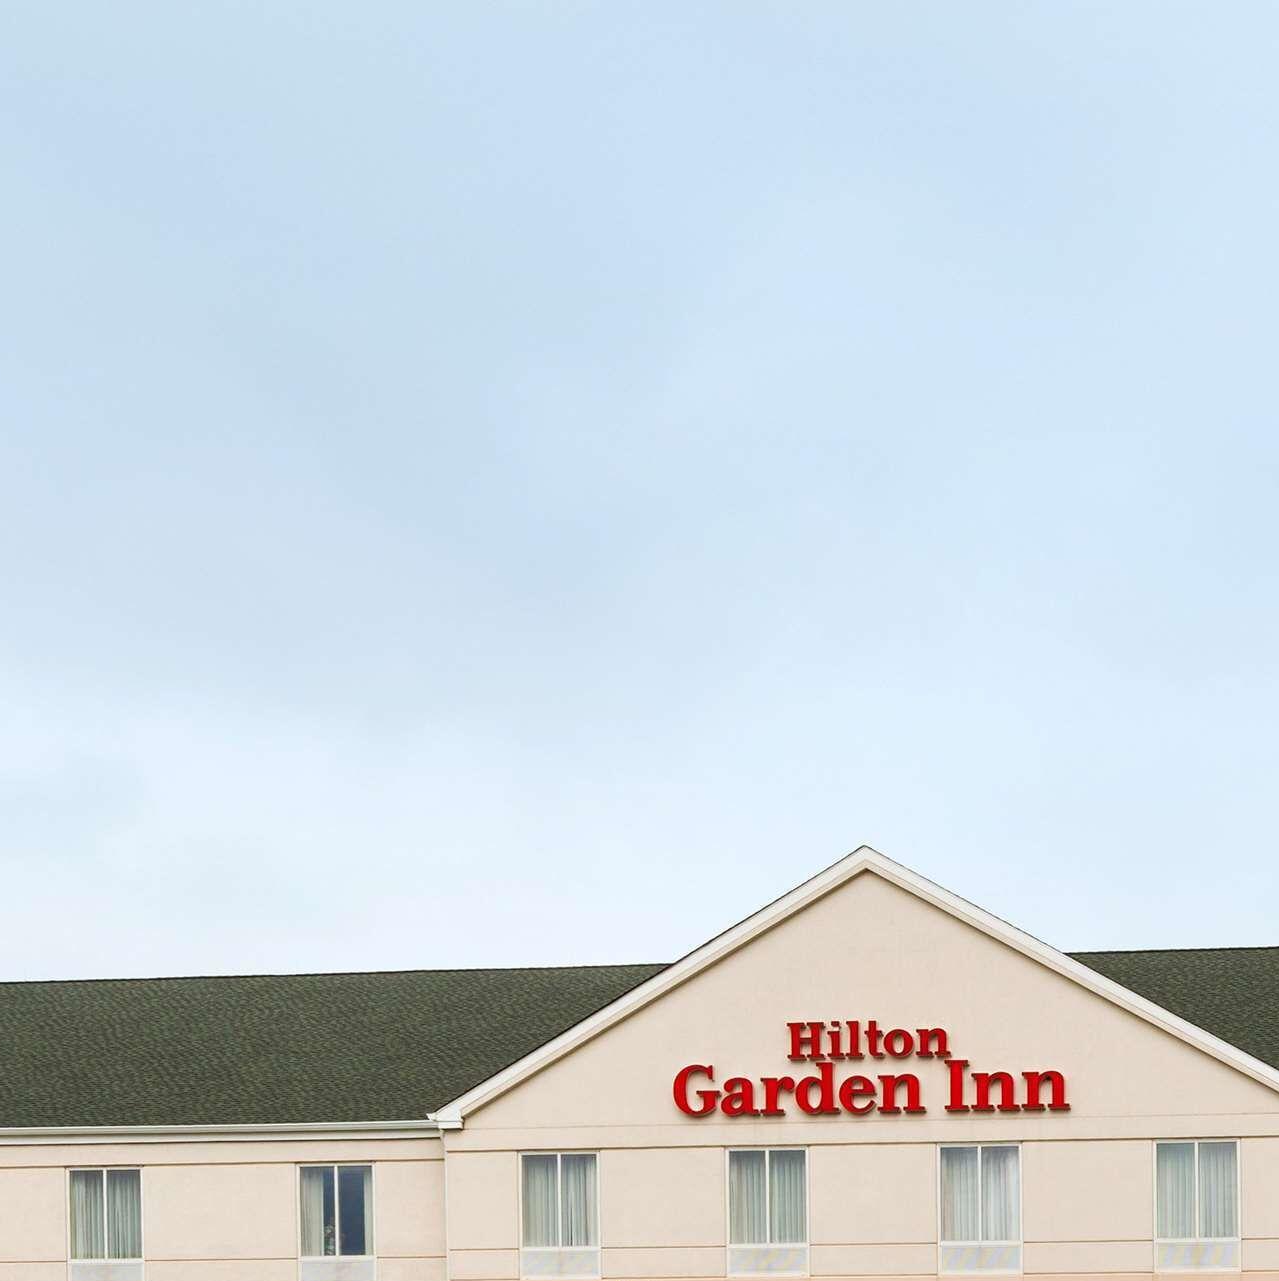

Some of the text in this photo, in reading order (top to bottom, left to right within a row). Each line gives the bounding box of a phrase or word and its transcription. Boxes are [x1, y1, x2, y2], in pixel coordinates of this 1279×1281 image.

[786, 1020, 952, 1062] Hilton
[672, 1059, 1071, 1118] Garden Inn
